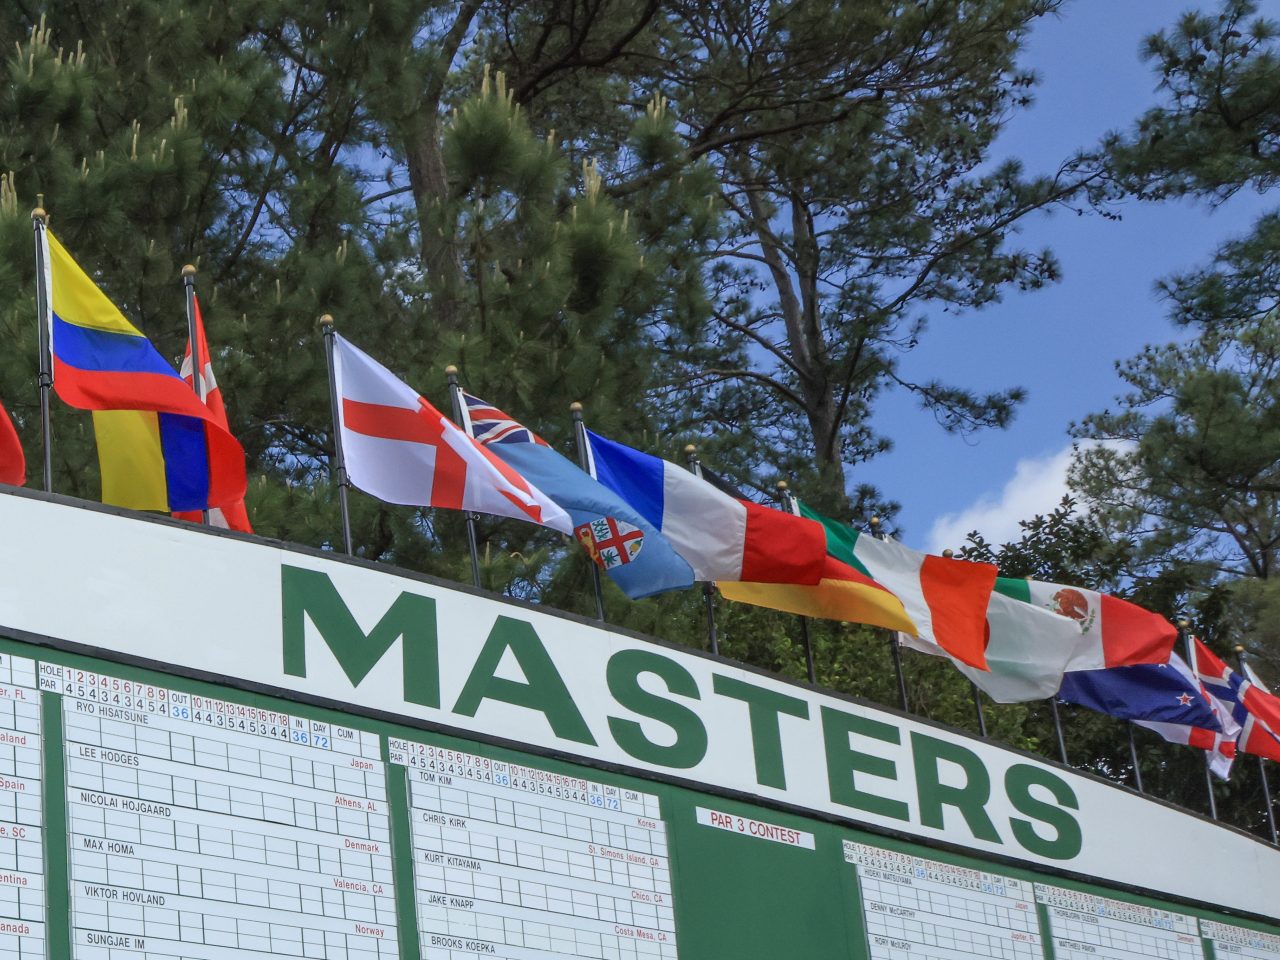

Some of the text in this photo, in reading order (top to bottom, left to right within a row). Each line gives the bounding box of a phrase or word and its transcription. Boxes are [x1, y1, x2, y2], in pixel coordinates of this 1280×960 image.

[14, 689, 26, 700] FL
[77, 701, 148, 724] RYO HISATSUNE
[282, 564, 1081, 861] MASTERS
[80, 747, 139, 767] LEE HODGES
[419, 771, 454, 785] TOM KIM
[81, 793, 170, 817] NICOLAI HOJGAARD
[423, 813, 466, 828] CHRIS KIRK
[710, 812, 800, 844] PAR 3 CONTEST
[82, 838, 134, 857] MAX HOMA
[345, 838, 380, 853] Denmark
[425, 853, 481, 870] KURT KITAYAMA
[85, 886, 165, 905] VIKTOR HOVLAND
[88, 933, 144, 949] SUNGJAE IM
[432, 936, 495, 953] BROOKS KOEPKA
